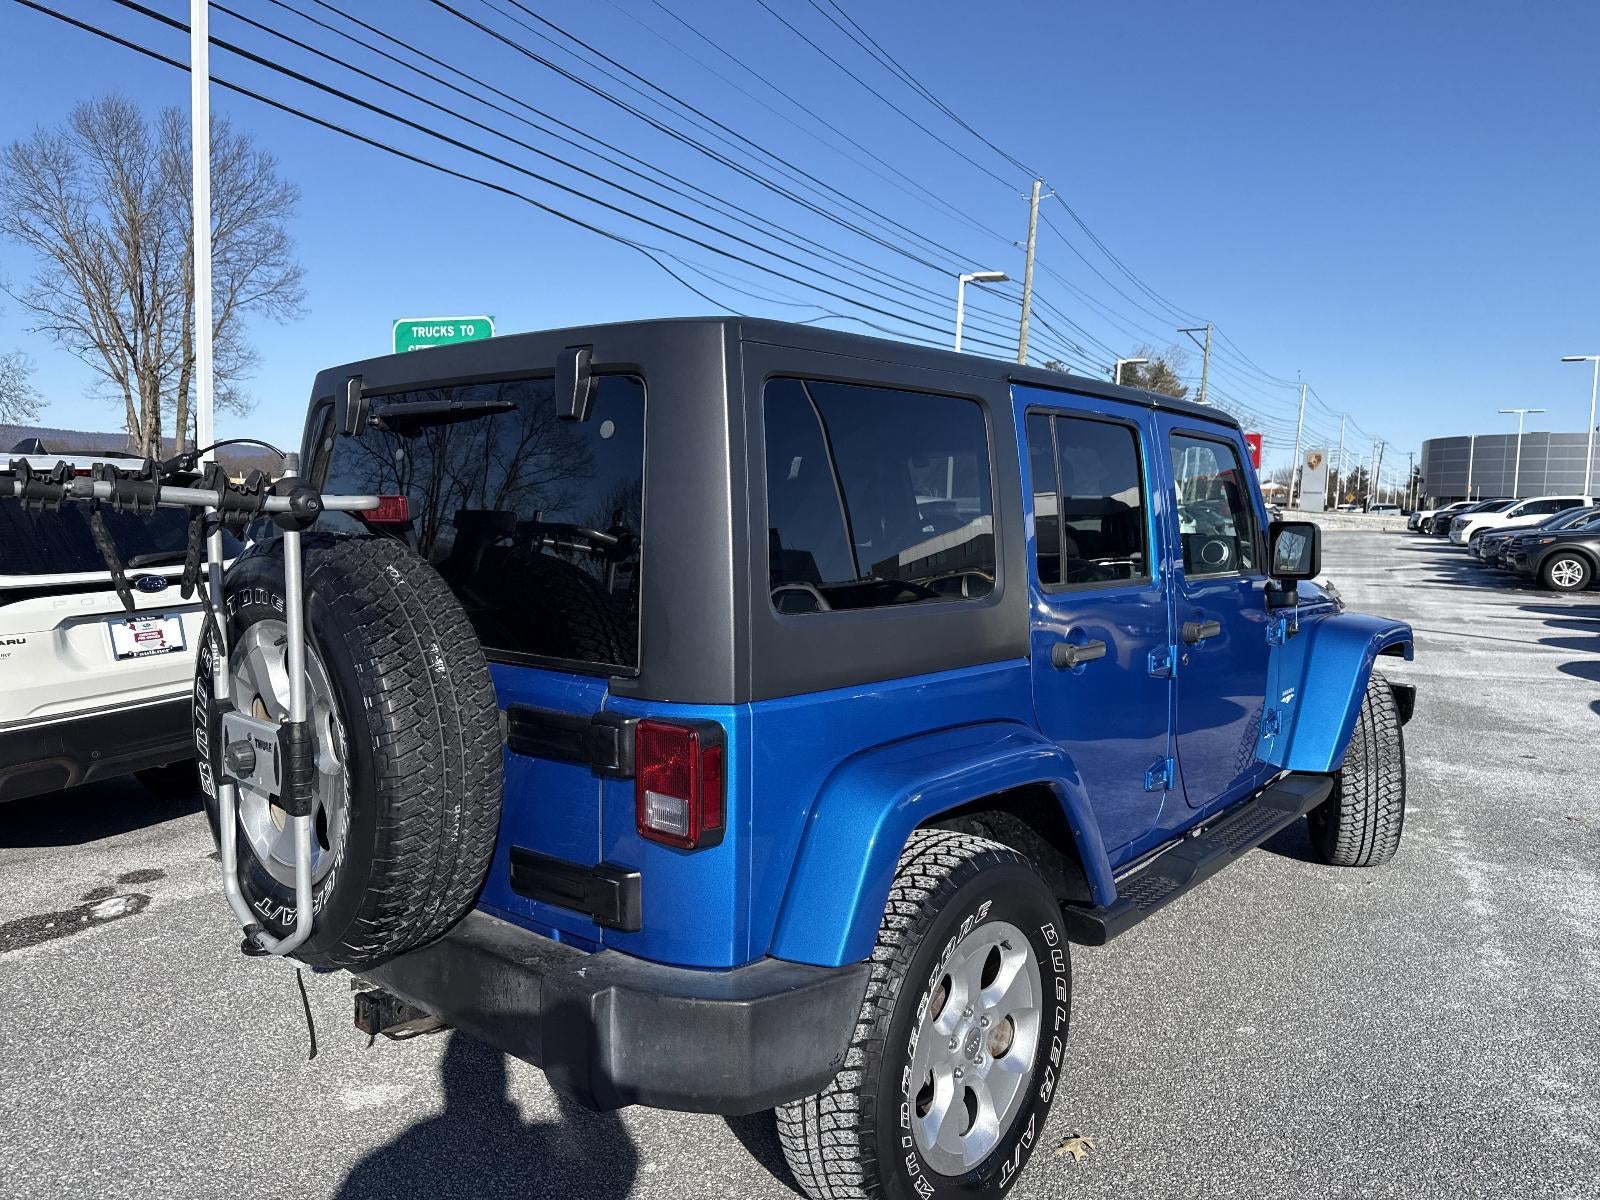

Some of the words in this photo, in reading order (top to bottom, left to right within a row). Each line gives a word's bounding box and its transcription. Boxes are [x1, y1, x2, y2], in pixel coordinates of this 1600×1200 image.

[411, 326, 455, 338] TRUCKS
[459, 325, 475, 337] TO
[1040, 922, 1068, 1103] DUELER
